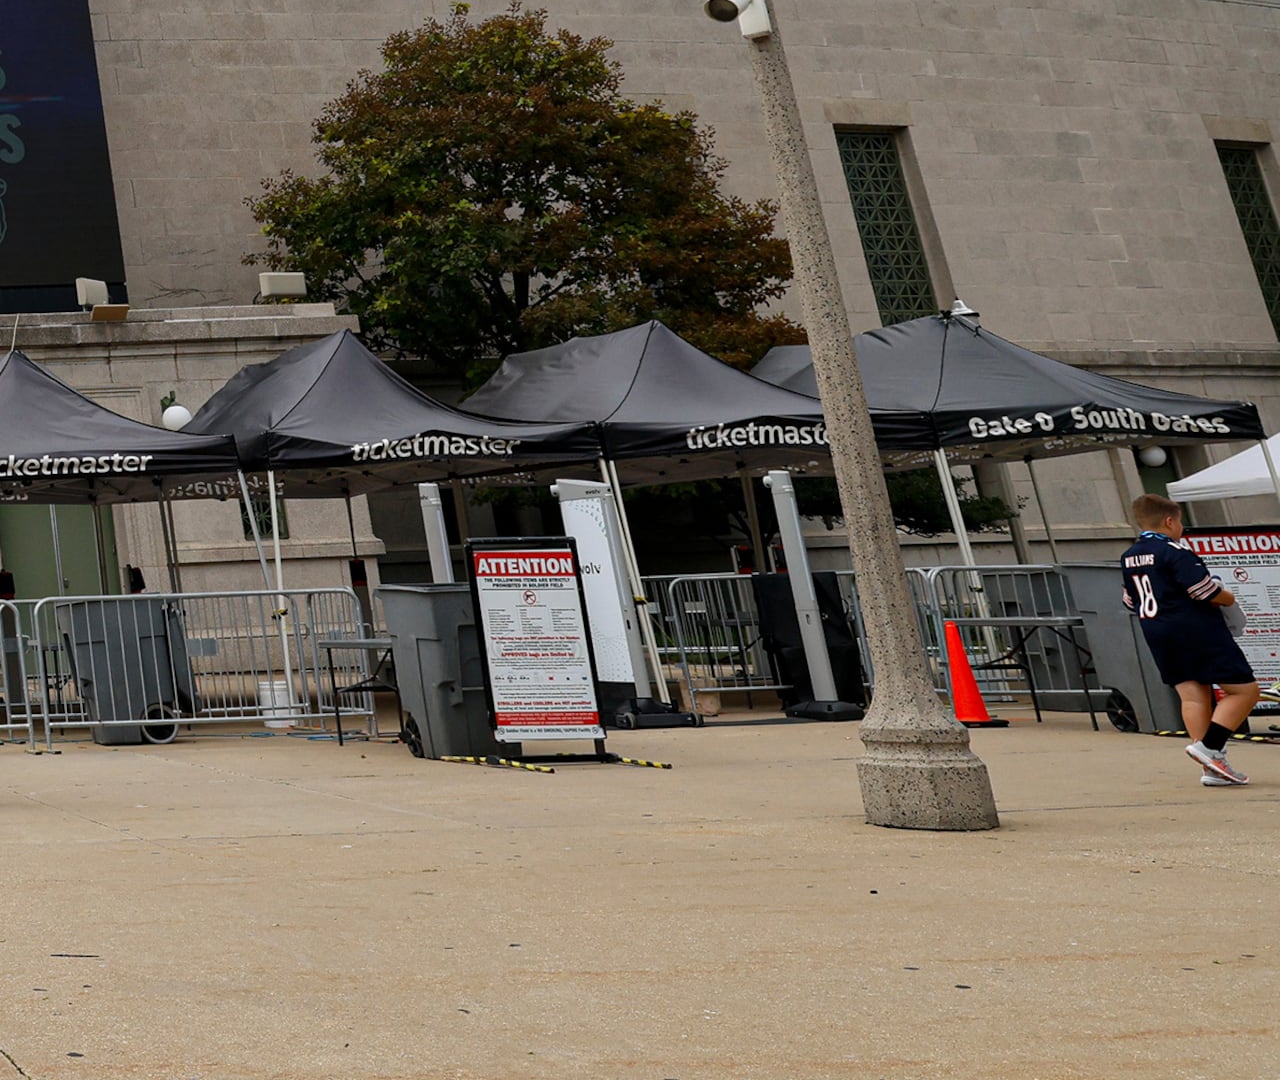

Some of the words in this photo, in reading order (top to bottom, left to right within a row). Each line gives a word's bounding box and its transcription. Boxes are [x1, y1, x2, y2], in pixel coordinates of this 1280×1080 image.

[685, 420, 830, 450] ticketmast
[968, 415, 1032, 438] Gate
[1070, 406, 1146, 430] South
[1151, 412, 1231, 435] Gates
[351, 433, 521, 462] ticketmaster
[478, 558, 574, 574] ATTENTION
[1125, 554, 1155, 568] WILLIAMS
[1132, 574, 1158, 619] 18
